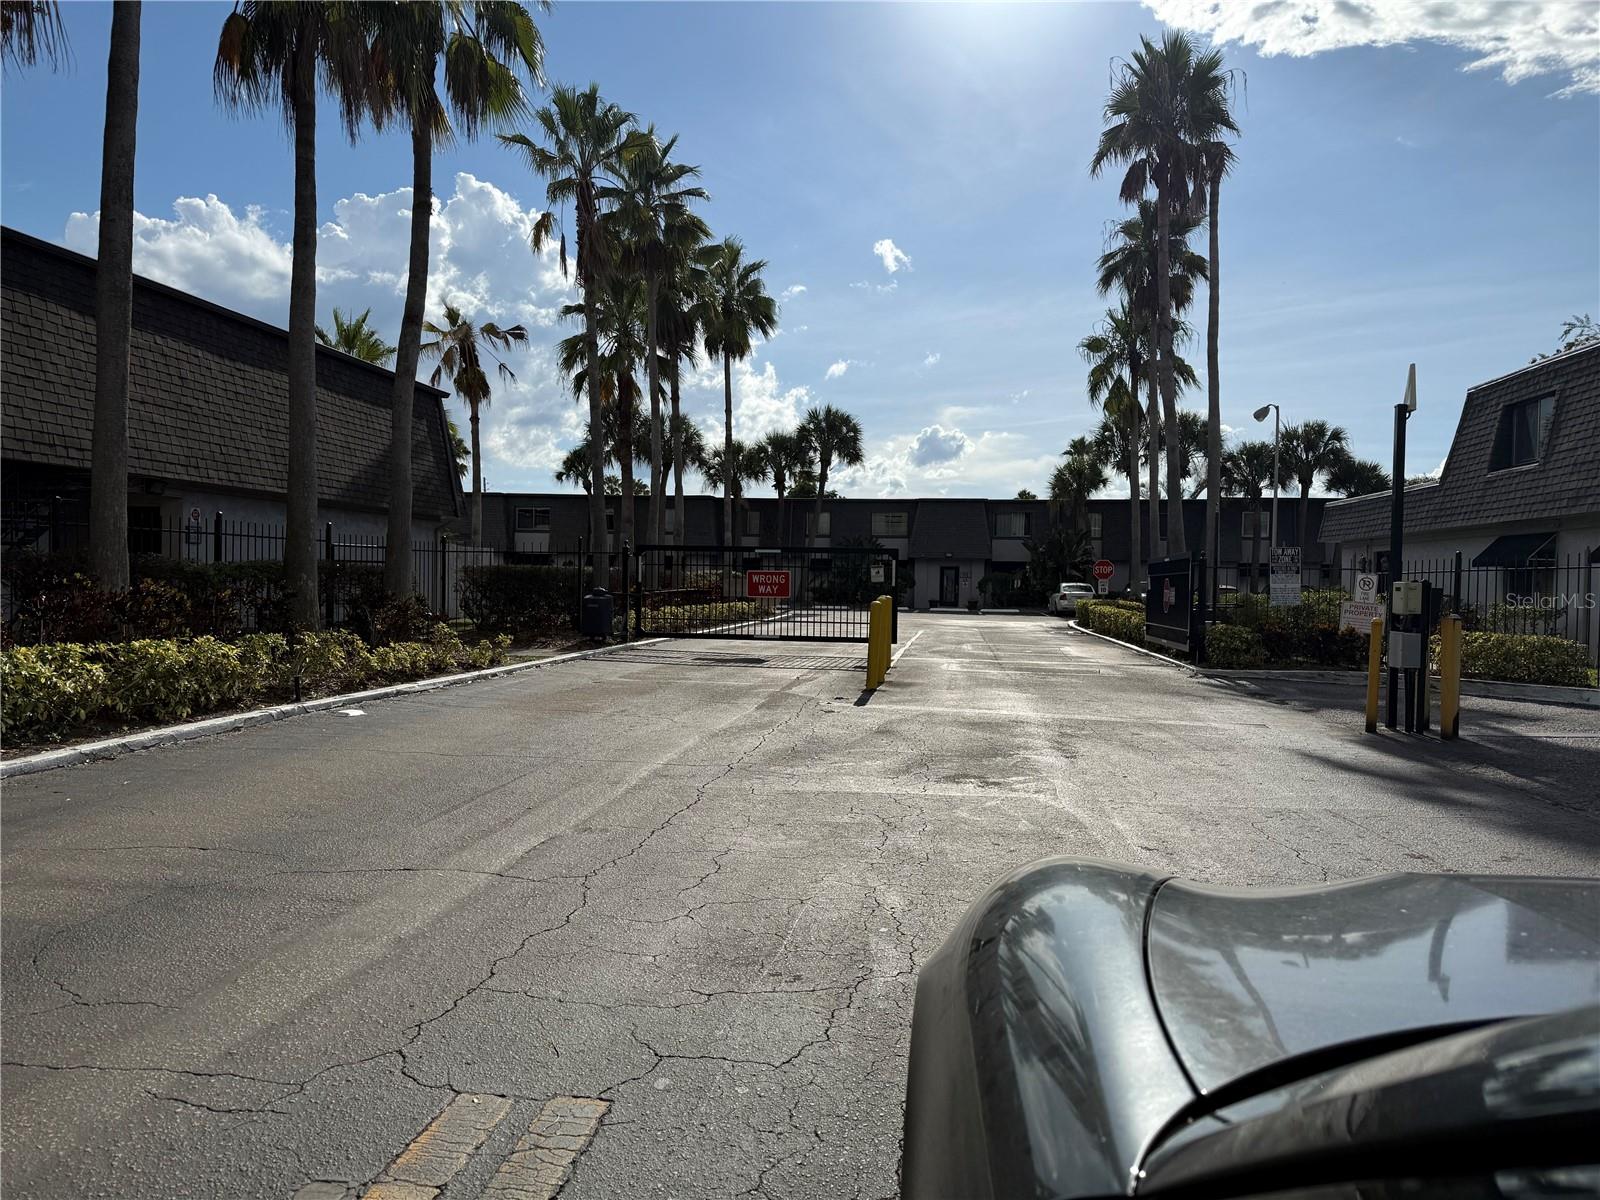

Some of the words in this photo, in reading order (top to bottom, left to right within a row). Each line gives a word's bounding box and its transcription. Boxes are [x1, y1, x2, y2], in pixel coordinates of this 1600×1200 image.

[1283, 548, 1298, 556] AWAY
[1095, 565, 1112, 574] STOP
[752, 574, 785, 584] WRONG
[758, 585, 778, 594] WAY
[1349, 604, 1379, 612] PRIVATE
[1344, 609, 1383, 618] PROPERTY
